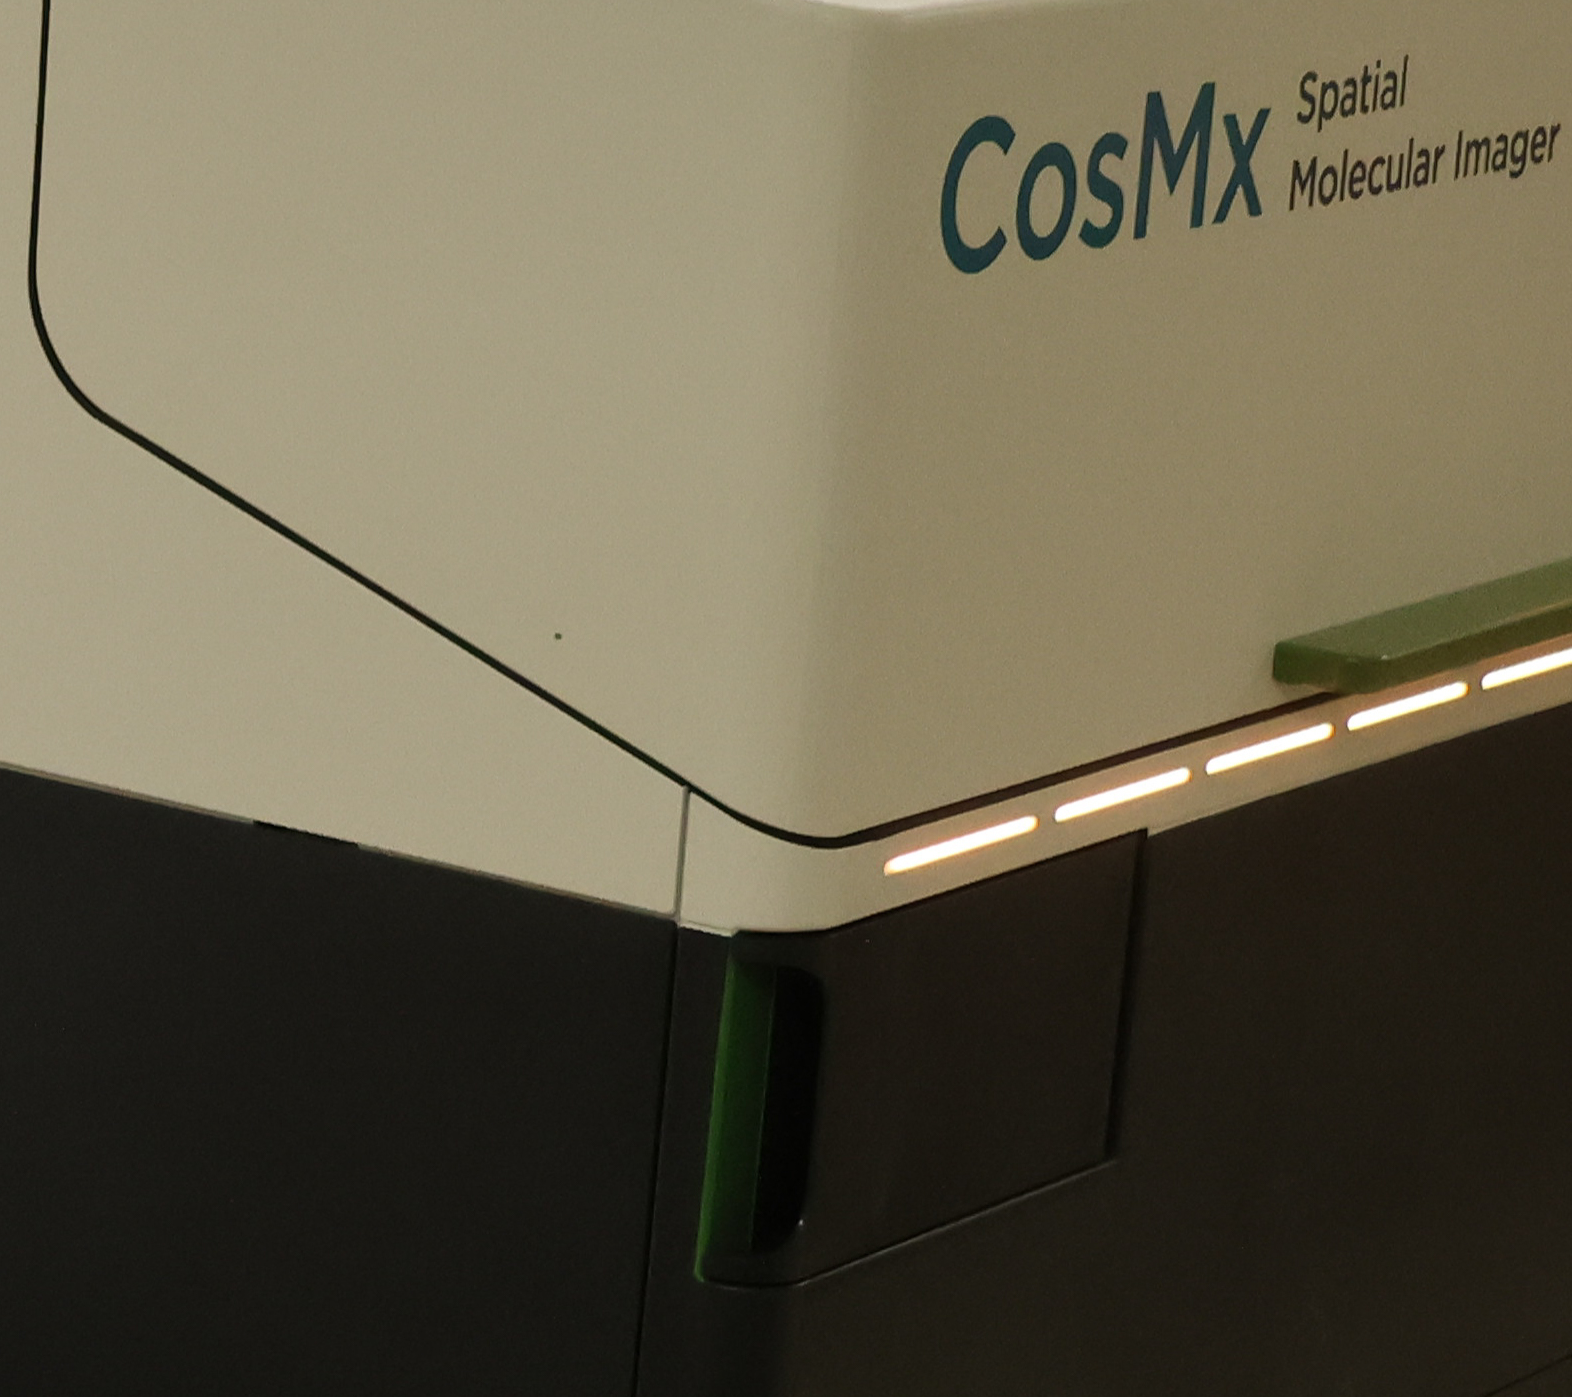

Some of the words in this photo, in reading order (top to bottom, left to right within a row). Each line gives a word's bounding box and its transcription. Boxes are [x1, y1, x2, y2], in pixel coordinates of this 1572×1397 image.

[1297, 54, 1410, 132] Spatial
[940, 81, 1271, 275] CosMx
[1289, 136, 1446, 211] Molecular
[1454, 122, 1561, 180] Imager
